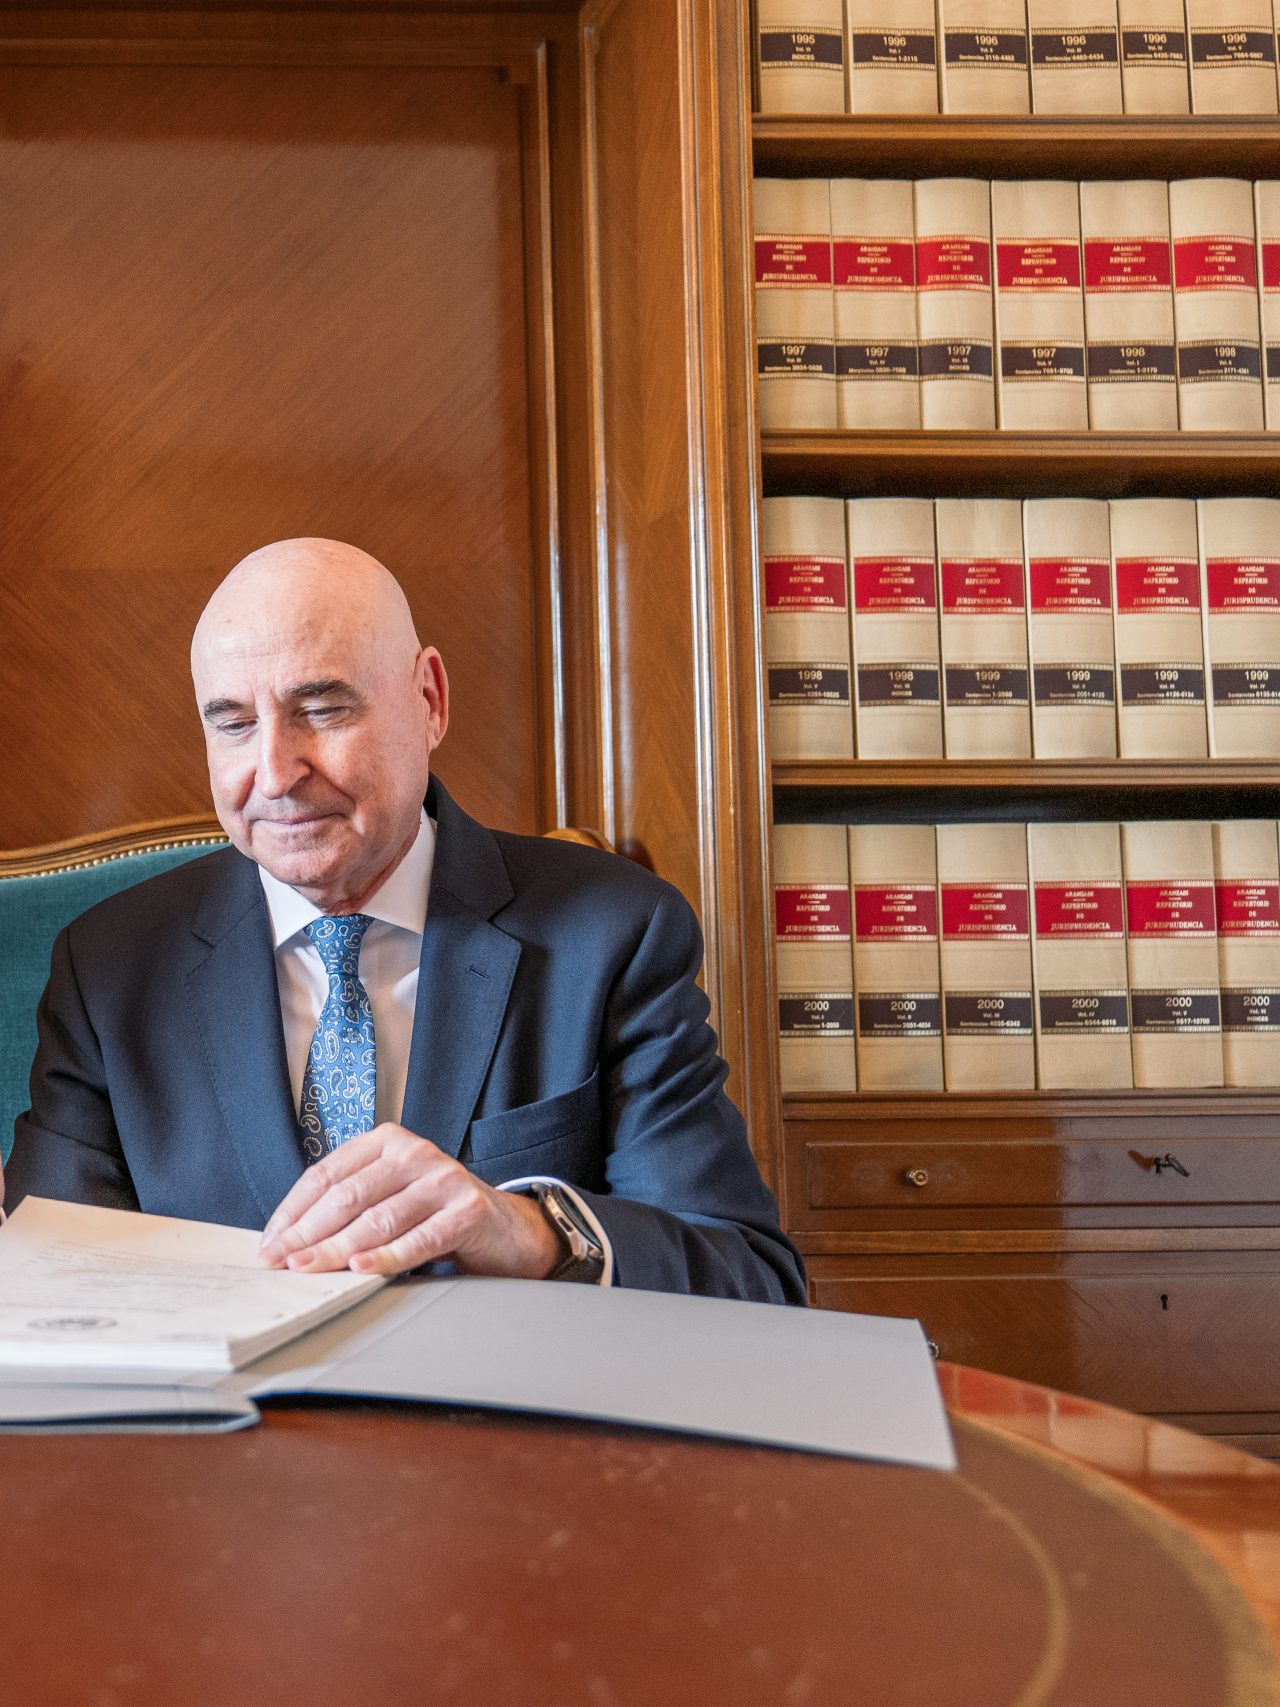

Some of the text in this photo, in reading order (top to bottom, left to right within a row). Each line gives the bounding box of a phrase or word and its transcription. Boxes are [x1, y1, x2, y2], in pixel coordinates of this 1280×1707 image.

[791, 35, 815, 44] 1995
[883, 37, 906, 46] 1996
[975, 36, 998, 45] 1996
[1061, 36, 1086, 45] 1996
[1143, 34, 1167, 43] 1996
[1222, 34, 1247, 43] 1996
[927, 275, 983, 283] JURISPRUDENCIA
[781, 346, 806, 355] 1997
[865, 348, 889, 356] 1997
[948, 346, 971, 355] 1997
[1032, 349, 1056, 358] 1997
[1121, 348, 1145, 357] 1998
[1215, 348, 1235, 357] 1998
[869, 597, 925, 605] JURISPRUDENCIA
[1133, 597, 1189, 605] JURISPRUDENCIA
[798, 671, 822, 680] 1998
[889, 671, 913, 680] 1998
[976, 671, 1000, 681] 1999
[1066, 671, 1090, 681] 1999
[1154, 671, 1178, 681] 1999
[1245, 671, 1268, 680] 1999
[785, 925, 840, 933] JURISPRUDENCIA
[978, 1000, 1004, 1009] 2000
[1072, 999, 1098, 1008] 2000
[1166, 997, 1192, 1007] 2000
[1244, 996, 1269, 1006] 2000
[804, 1001, 829, 1011] 2000
[891, 1001, 916, 1011] 2000
